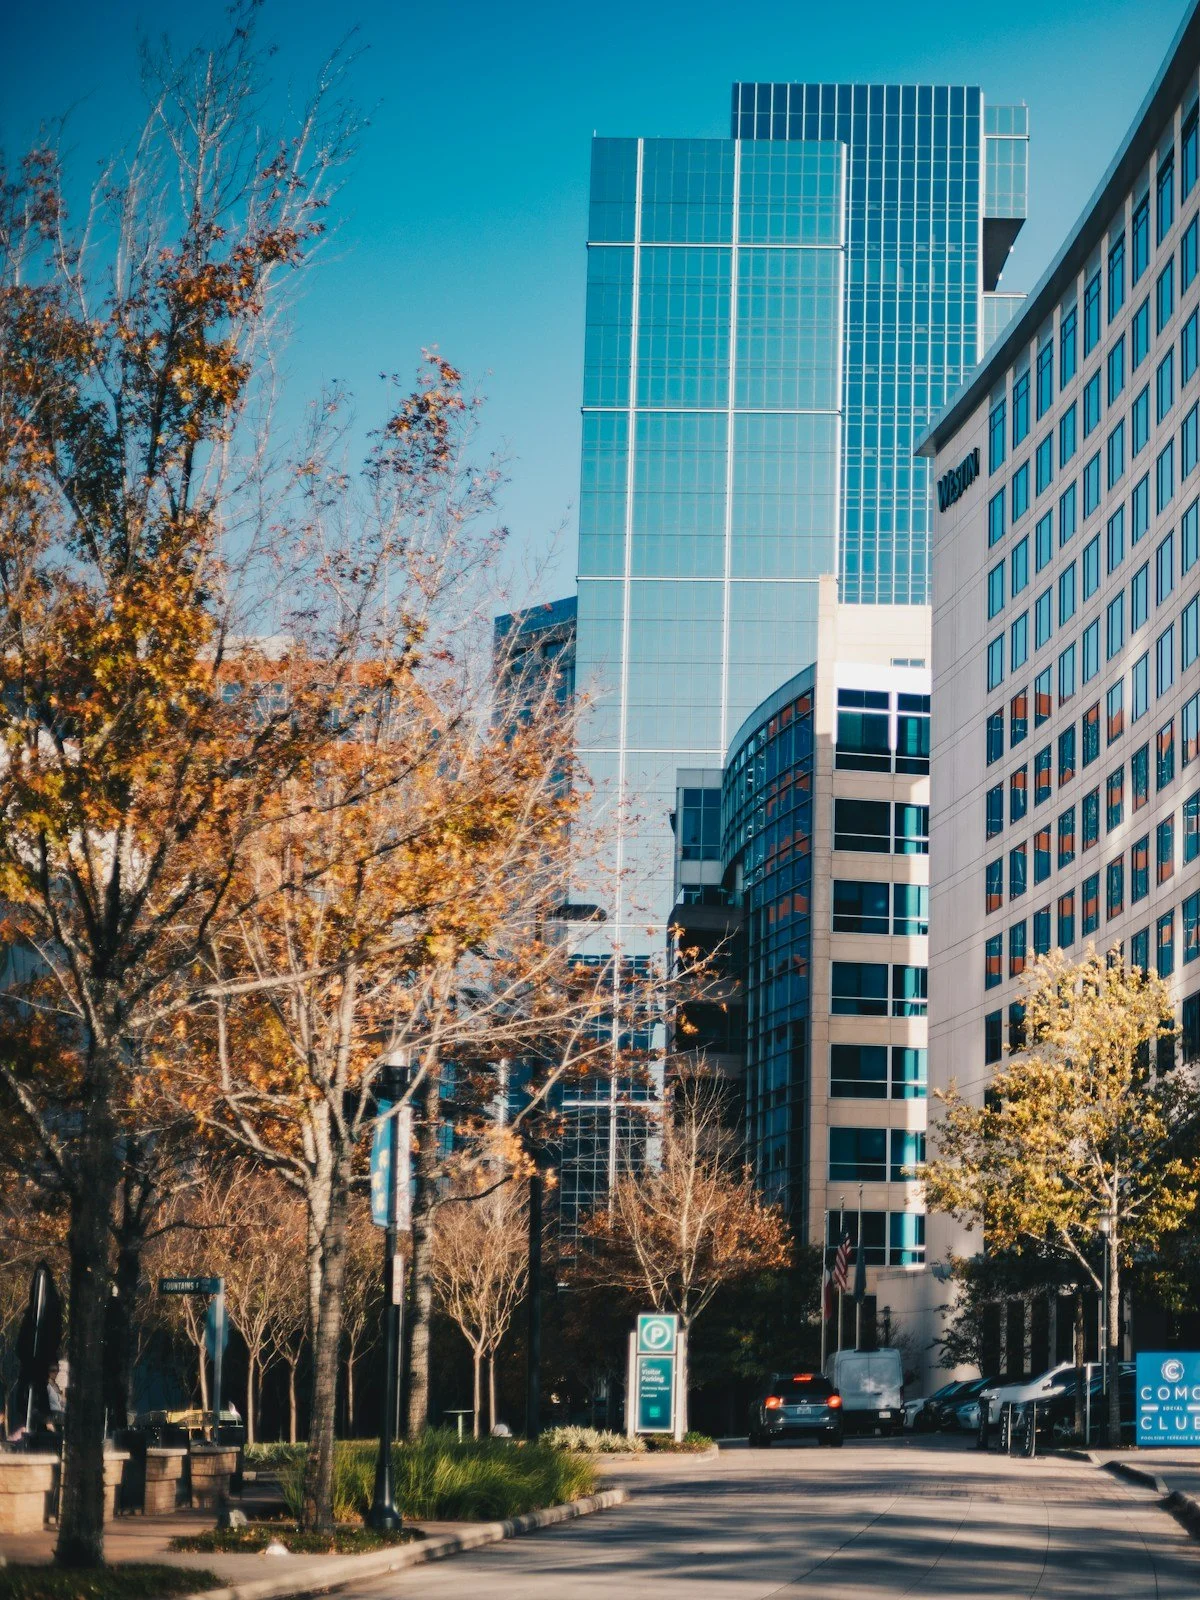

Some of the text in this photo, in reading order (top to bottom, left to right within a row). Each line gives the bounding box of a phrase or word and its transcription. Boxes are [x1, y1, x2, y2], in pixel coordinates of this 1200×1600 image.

[163, 1281, 194, 1290] FOUNTAINS
[651, 1327, 664, 1343] P
[641, 1376, 665, 1384] Parking
